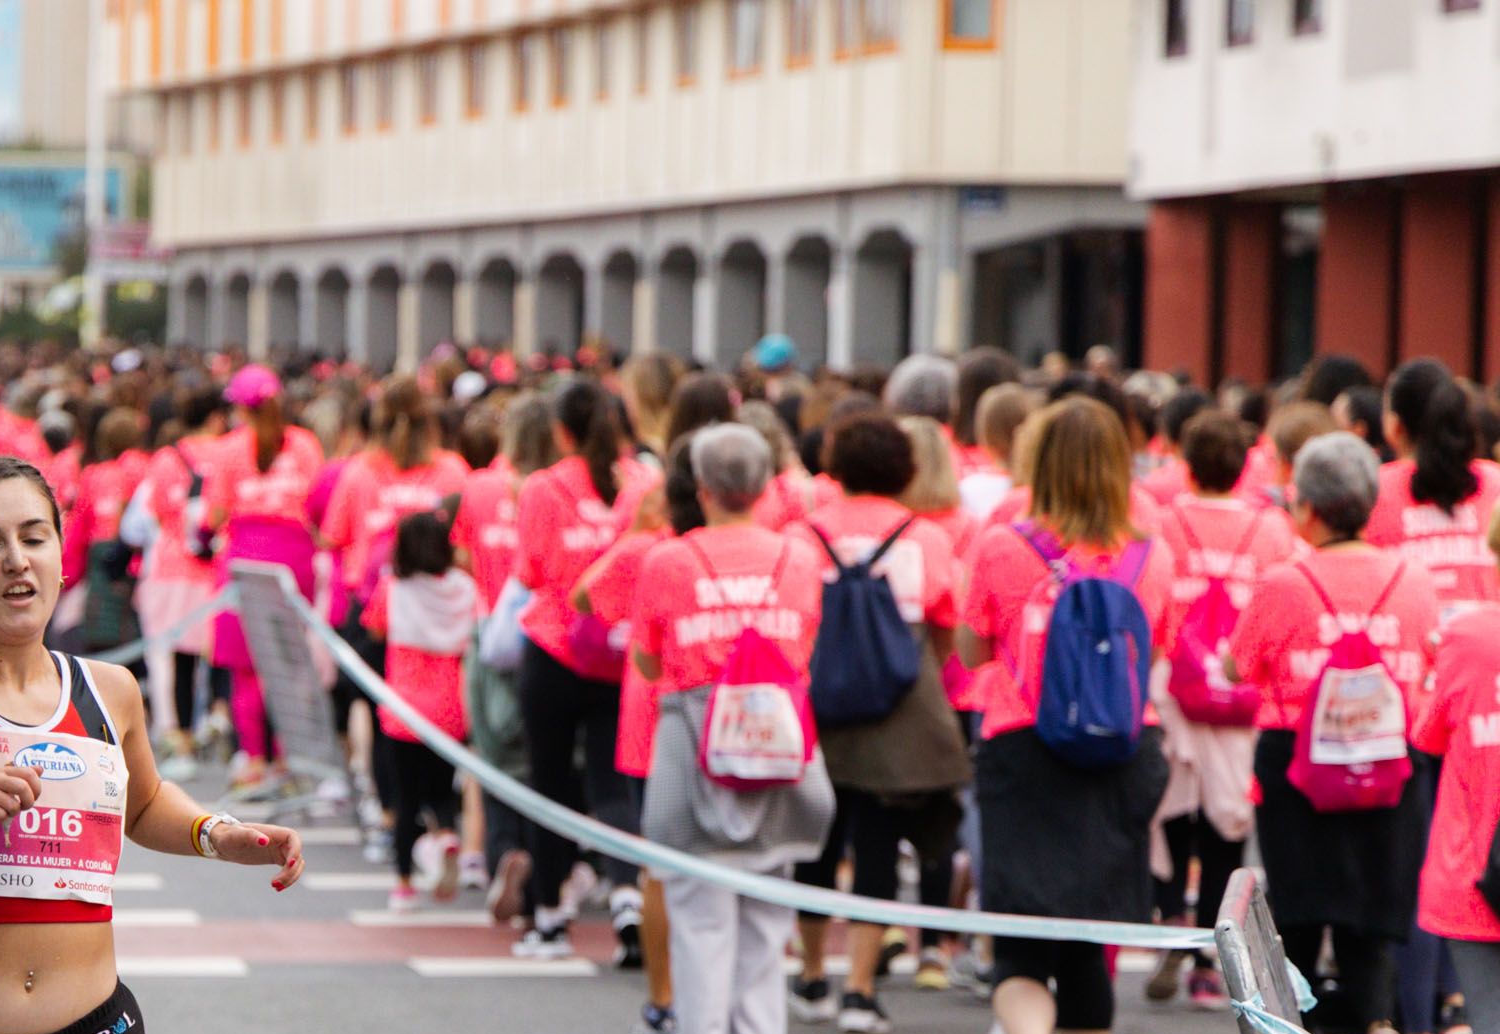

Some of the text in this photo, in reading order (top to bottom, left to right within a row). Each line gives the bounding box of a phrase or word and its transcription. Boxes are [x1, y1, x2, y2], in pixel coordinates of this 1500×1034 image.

[21, 752, 82, 773] ASTURIANA
[19, 809, 83, 837] 016
[40, 841, 61, 854] 711
[17, 854, 28, 864] DE
[30, 855, 41, 865] LA
[43, 856, 71, 867] MUJER
[78, 859, 84, 868] A
[85, 860, 112, 871] CORUÑA
[68, 879, 112, 894] Santander
